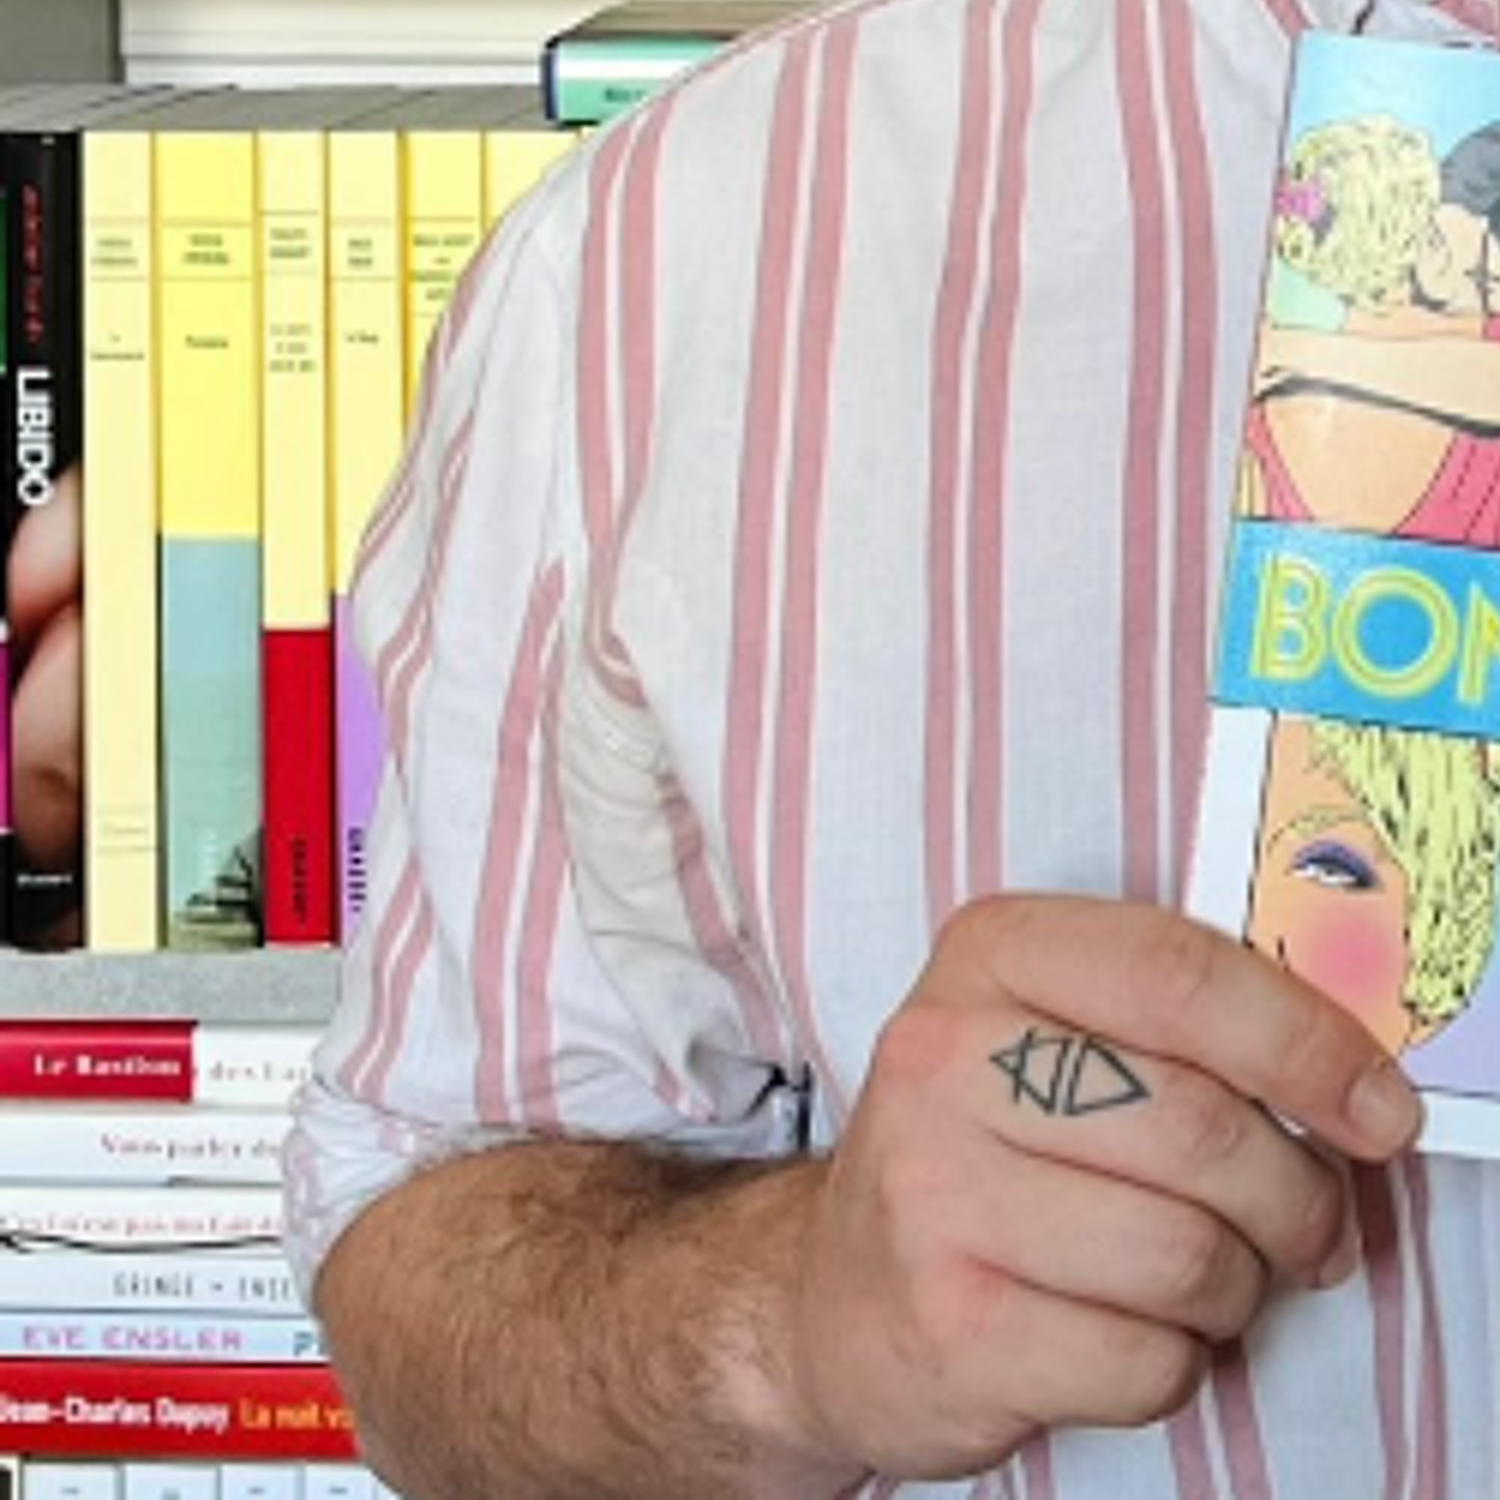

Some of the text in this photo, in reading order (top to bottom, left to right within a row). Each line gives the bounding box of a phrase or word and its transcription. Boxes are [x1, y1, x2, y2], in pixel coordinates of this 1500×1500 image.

[16, 366, 54, 507] LIBIDO
[35, 1054, 181, 1077] Le Bastion
[22, 1325, 88, 1350] EVE
[100, 1326, 244, 1352] ENSLER
